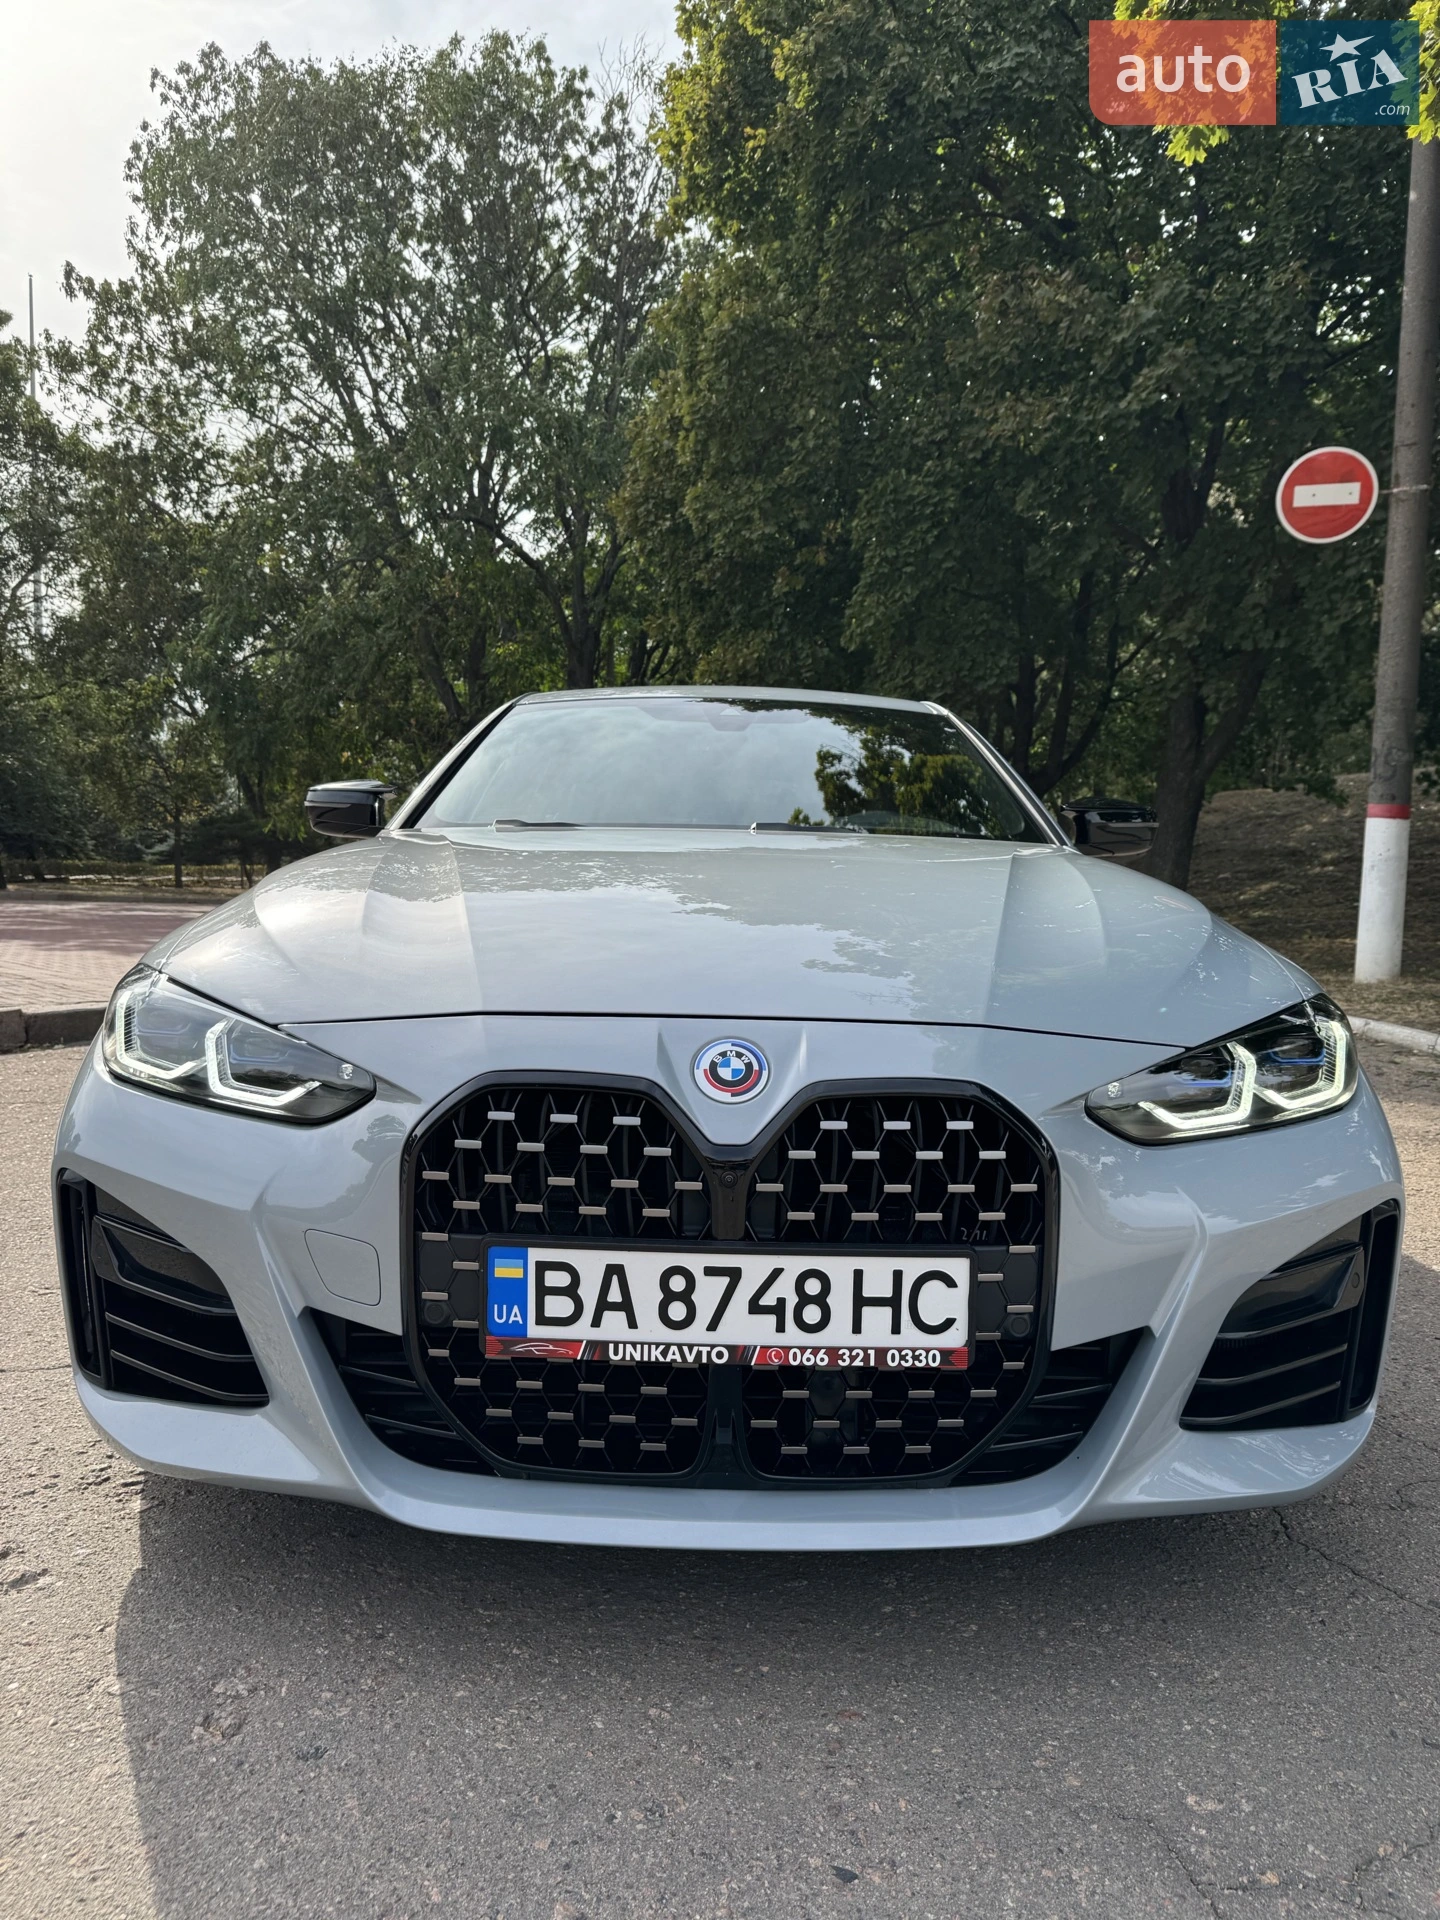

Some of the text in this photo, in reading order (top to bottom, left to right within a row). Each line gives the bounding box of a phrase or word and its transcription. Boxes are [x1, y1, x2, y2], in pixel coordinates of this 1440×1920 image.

[712, 1050, 751, 1064] BMW
[534, 1259, 958, 1335] BA 8748 HC
[494, 1304, 524, 1325] UA
[608, 1343, 941, 1368] UNIKAVTO 066 321 0330
